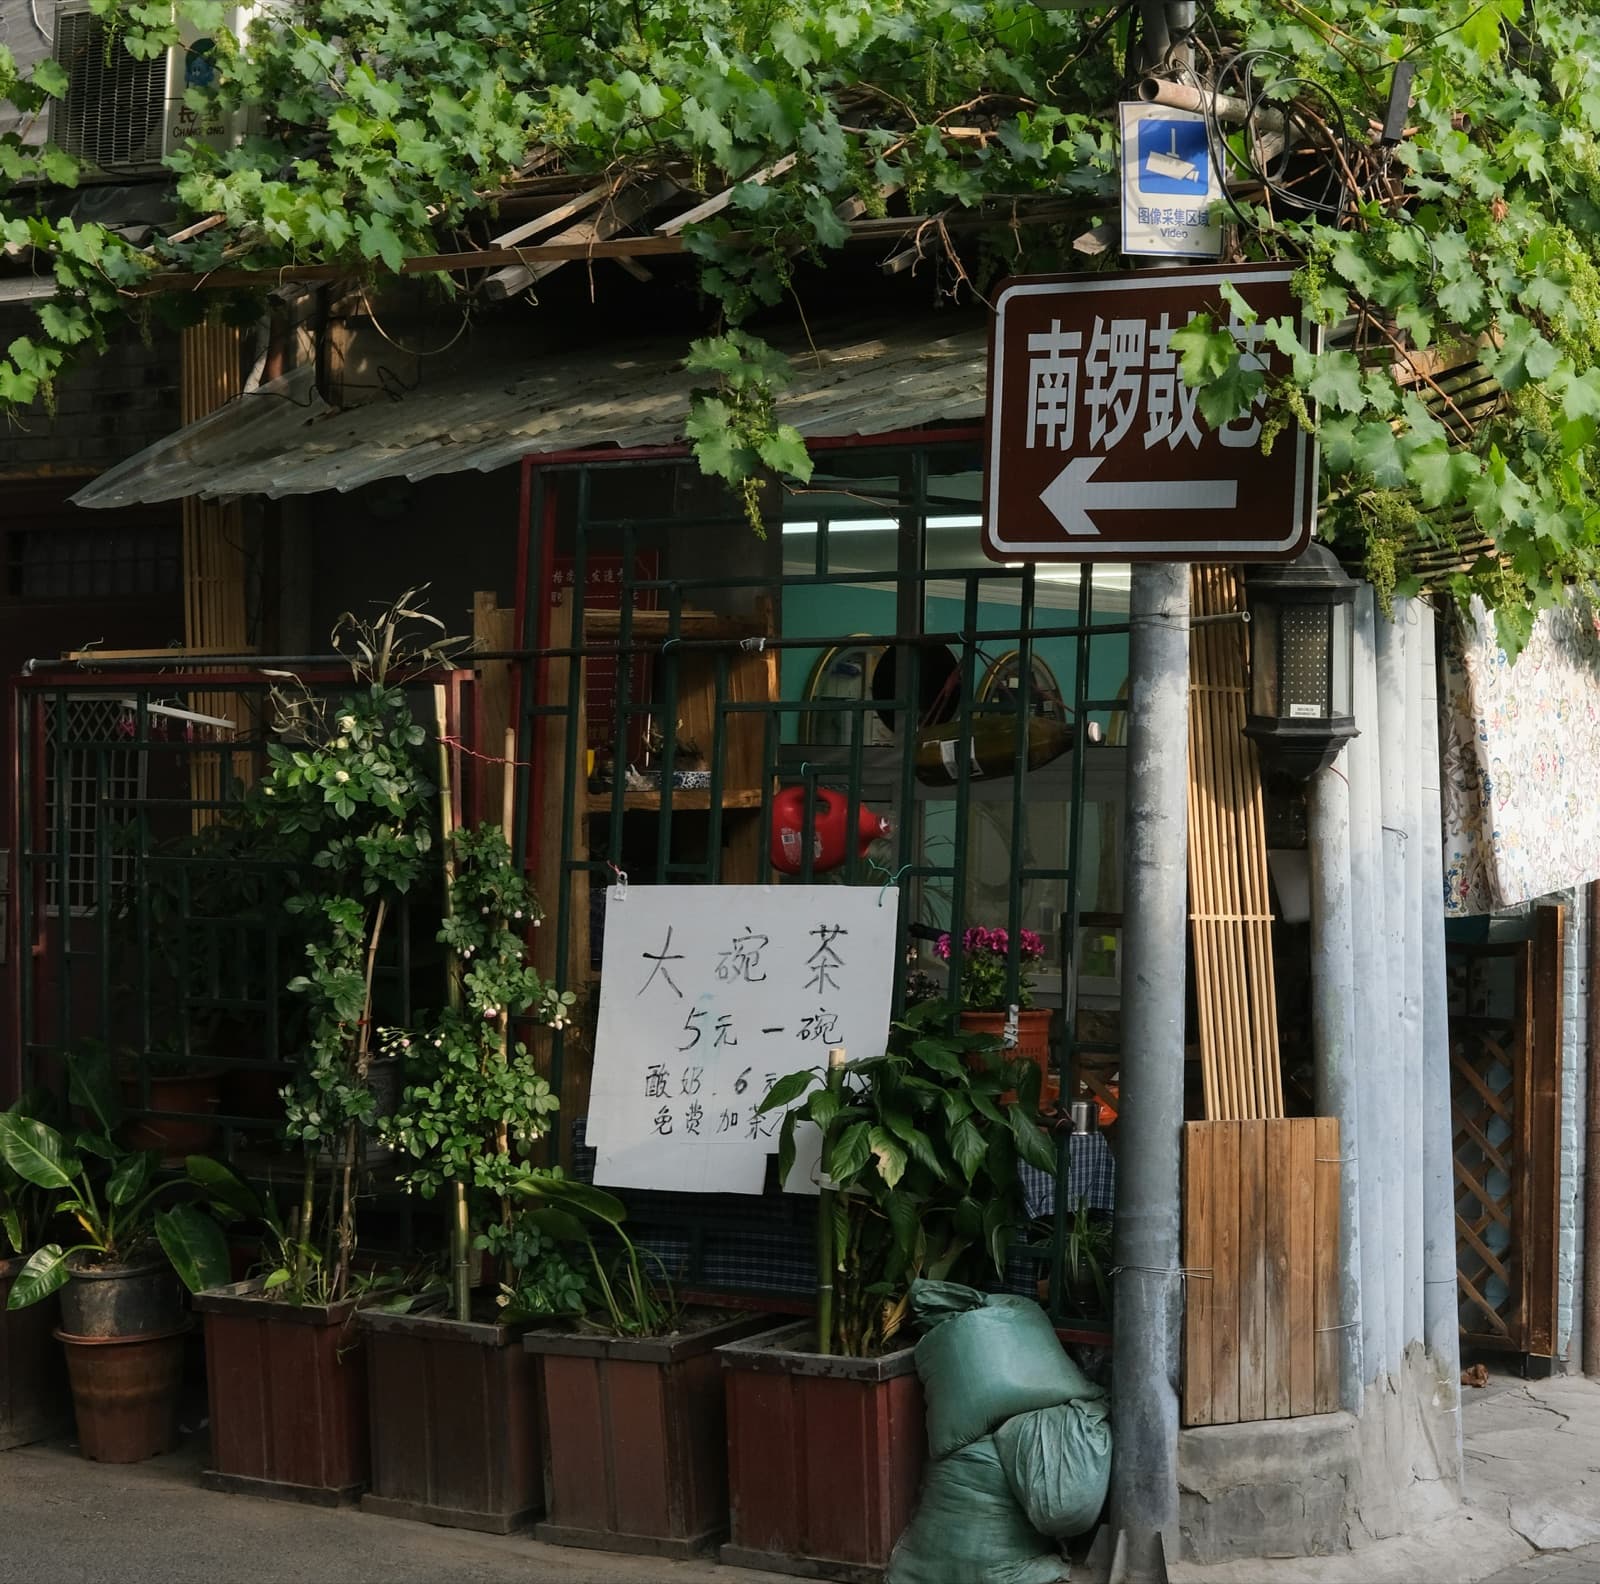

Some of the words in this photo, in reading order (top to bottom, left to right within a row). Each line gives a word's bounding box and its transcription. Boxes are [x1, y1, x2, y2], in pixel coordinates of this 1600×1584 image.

[172, 126, 225, 138] CHANGONG
[1138, 207, 1210, 227] 图像采集区域
[1160, 228, 1188, 239] Video
[637, 923, 848, 998] 大碗茶
[678, 1007, 844, 1052] 5元一碗
